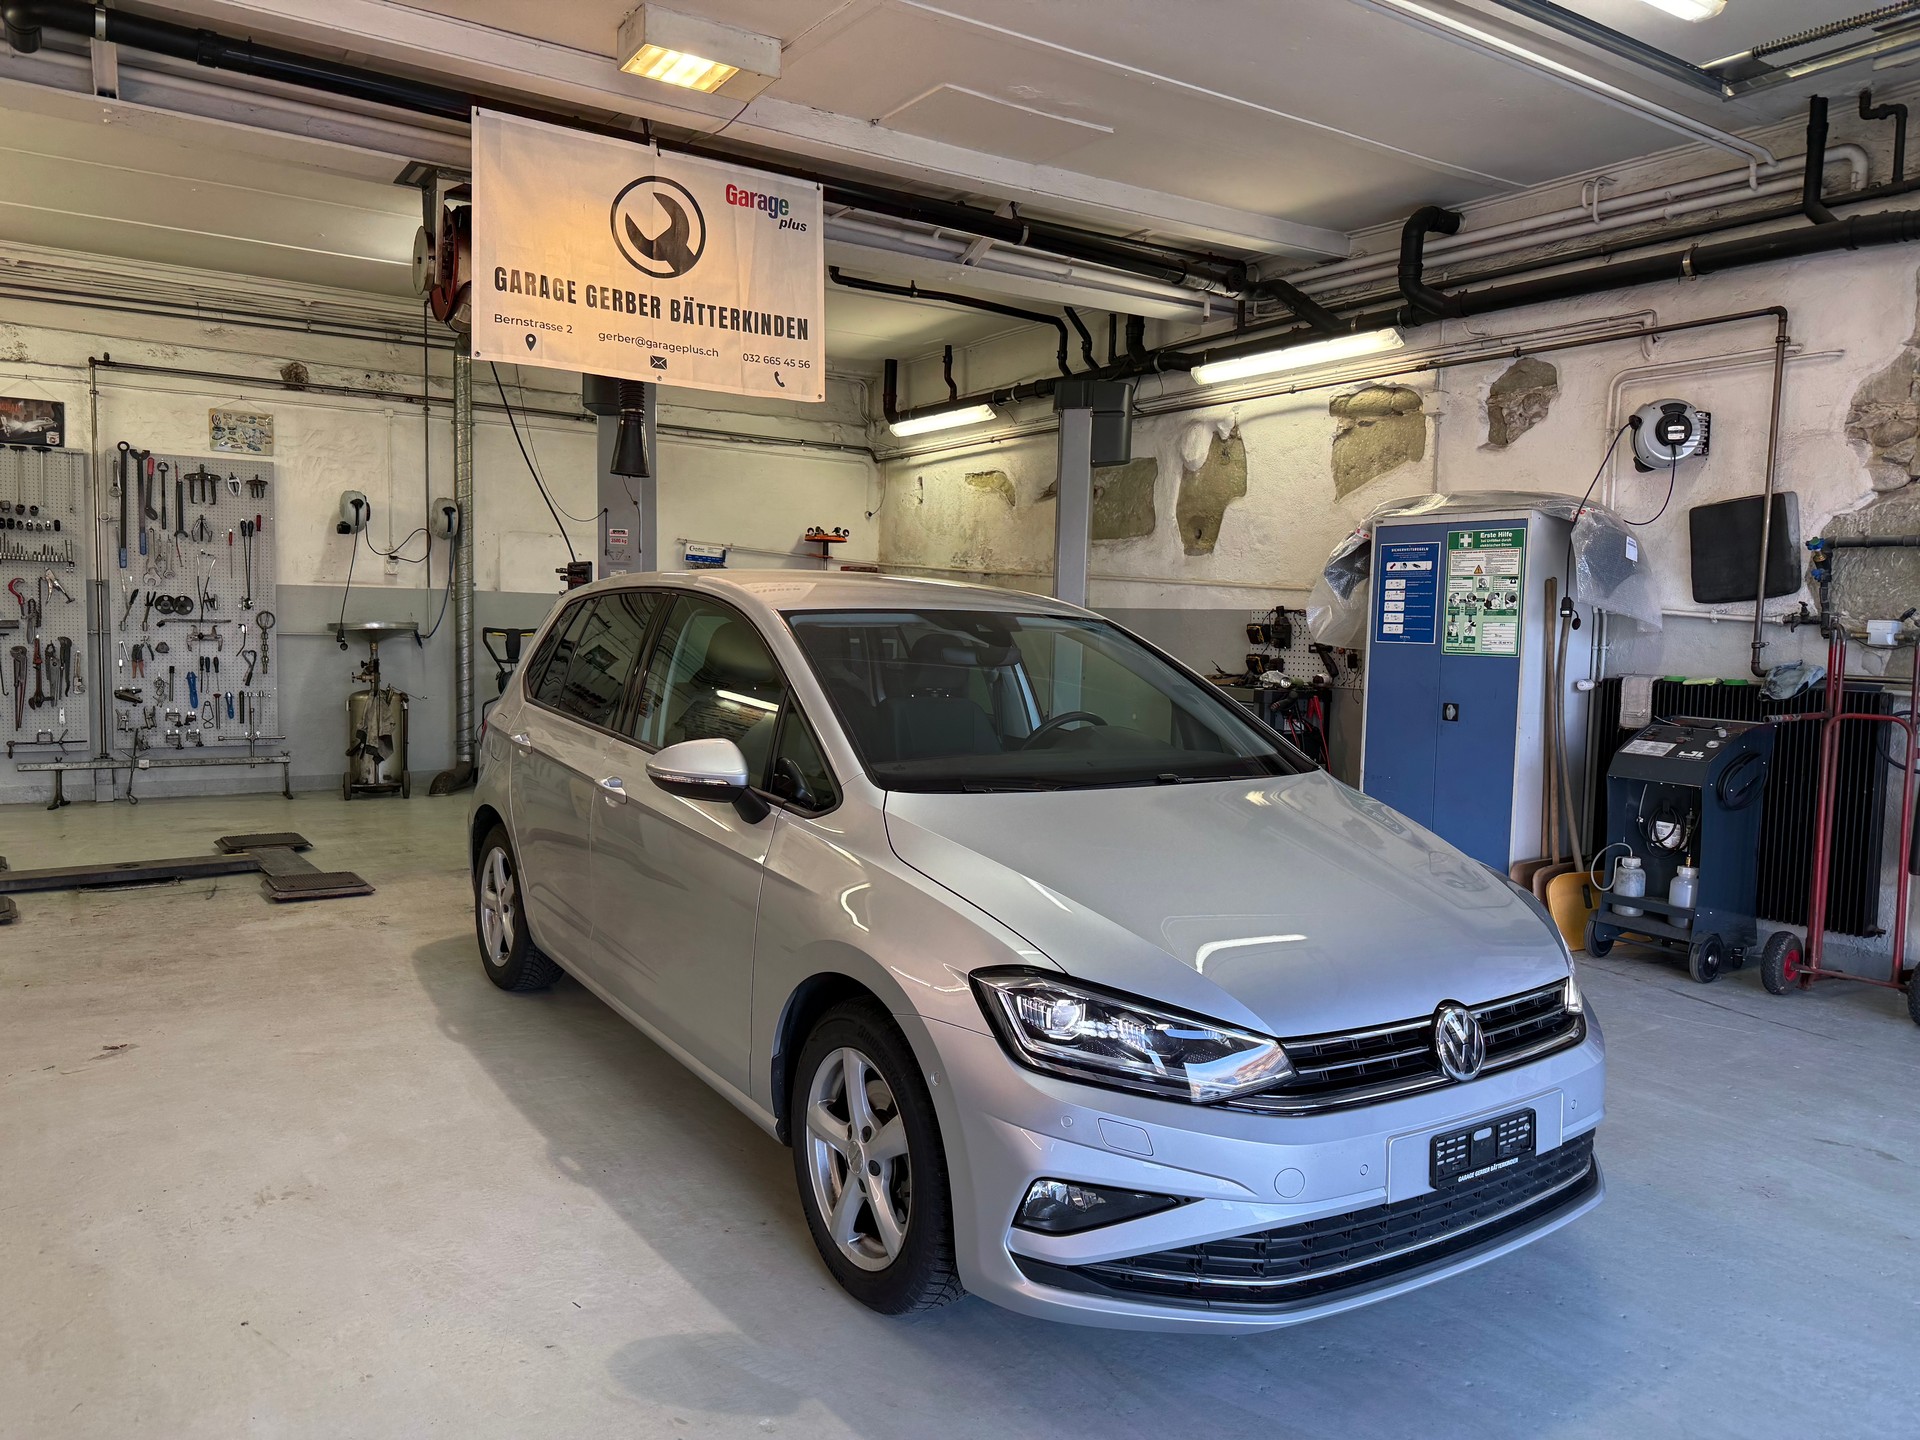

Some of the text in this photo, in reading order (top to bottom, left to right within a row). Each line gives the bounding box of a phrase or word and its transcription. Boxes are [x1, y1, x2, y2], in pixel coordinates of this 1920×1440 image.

[726, 184, 789, 219] Garage
[779, 218, 807, 231] plus
[494, 266, 808, 340] GARAGE GERBER BÄTTERKINDEN
[494, 313, 573, 334] Bernstrasse 2
[598, 332, 719, 357] gerber@garageplus.ch
[742, 353, 811, 369] 032 665 45 56
